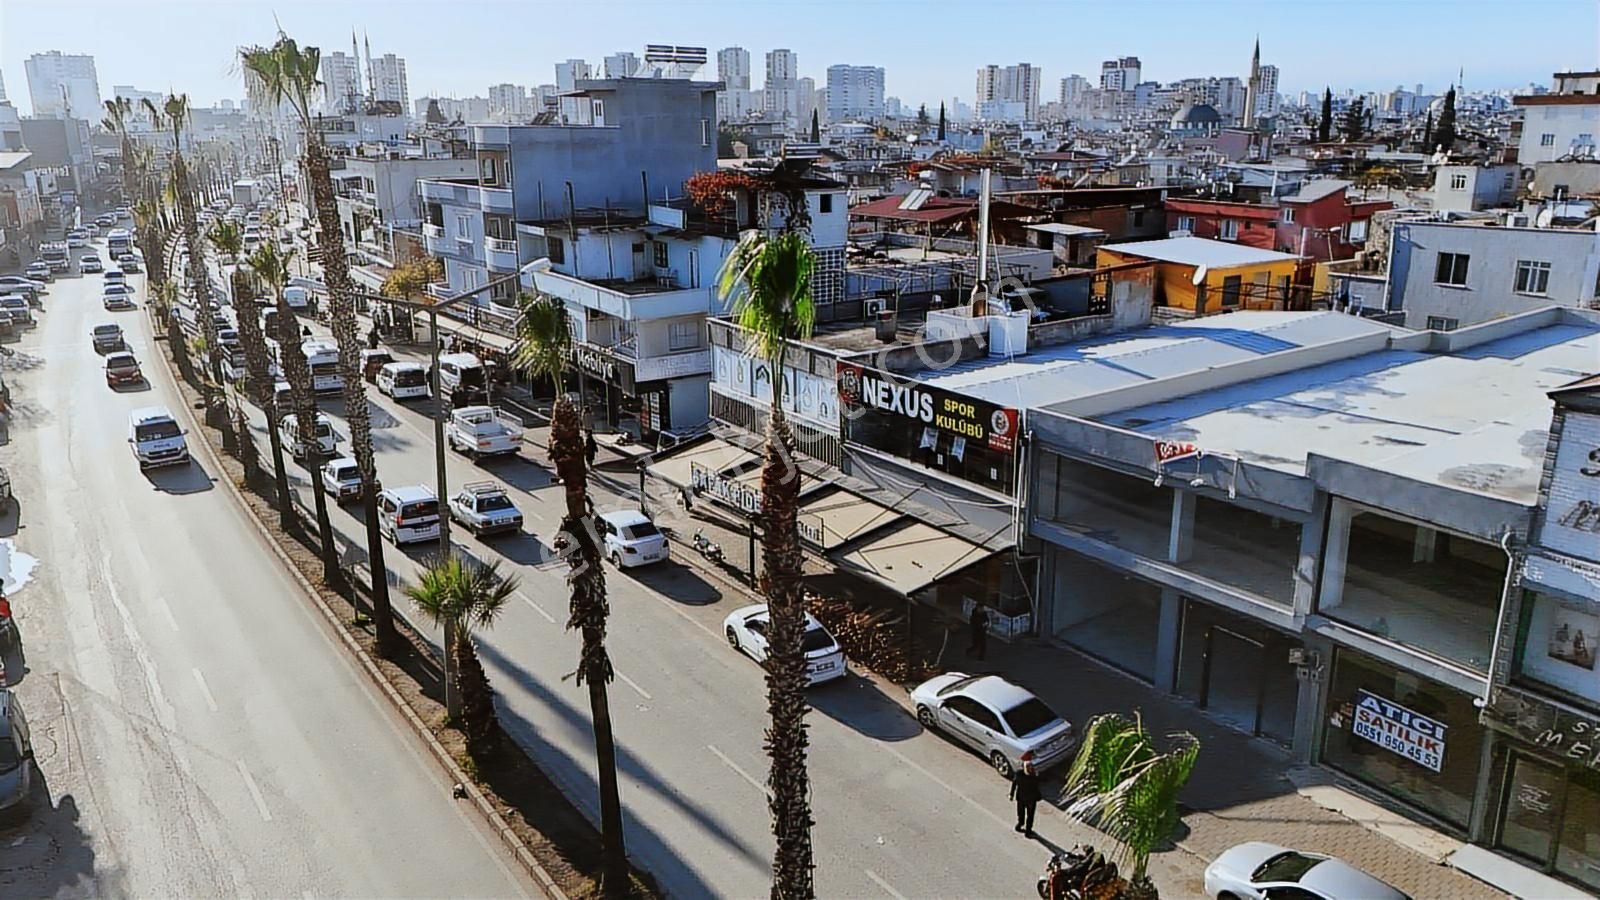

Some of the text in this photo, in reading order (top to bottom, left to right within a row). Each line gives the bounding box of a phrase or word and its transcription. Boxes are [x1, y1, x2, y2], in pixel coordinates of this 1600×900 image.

[577, 348, 613, 380] Mobilya
[862, 375, 934, 423] NEXUS
[944, 398, 976, 419] SPOR
[935, 414, 983, 439] KULÜBÜ
[1358, 709, 1440, 755] SATILIK
[1360, 696, 1444, 740] ATICI
[1356, 722, 1439, 769] 0551 950 45 53
